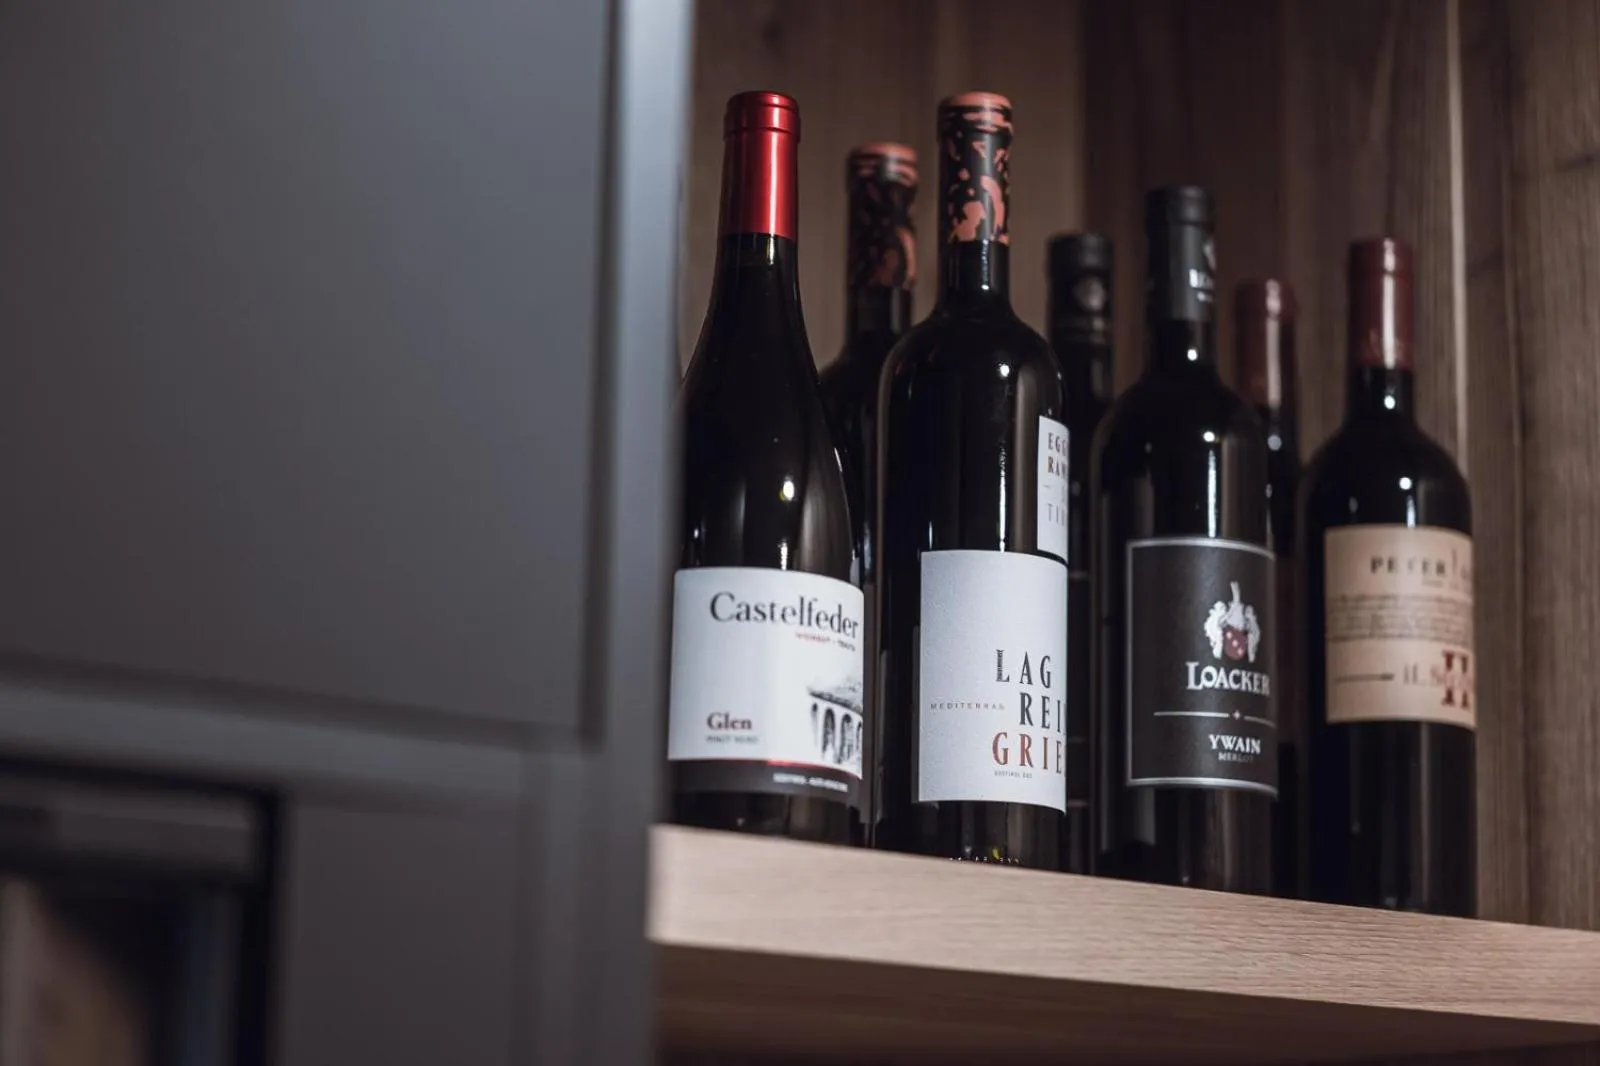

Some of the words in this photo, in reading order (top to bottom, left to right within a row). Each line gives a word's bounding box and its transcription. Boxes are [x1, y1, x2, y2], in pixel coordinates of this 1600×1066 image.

[709, 591, 858, 639] Castelfeder
[995, 649, 1051, 689] LAG
[1184, 661, 1271, 697] LOACKER
[706, 711, 753, 730] Glen
[1208, 733, 1262, 755] YWAIN
